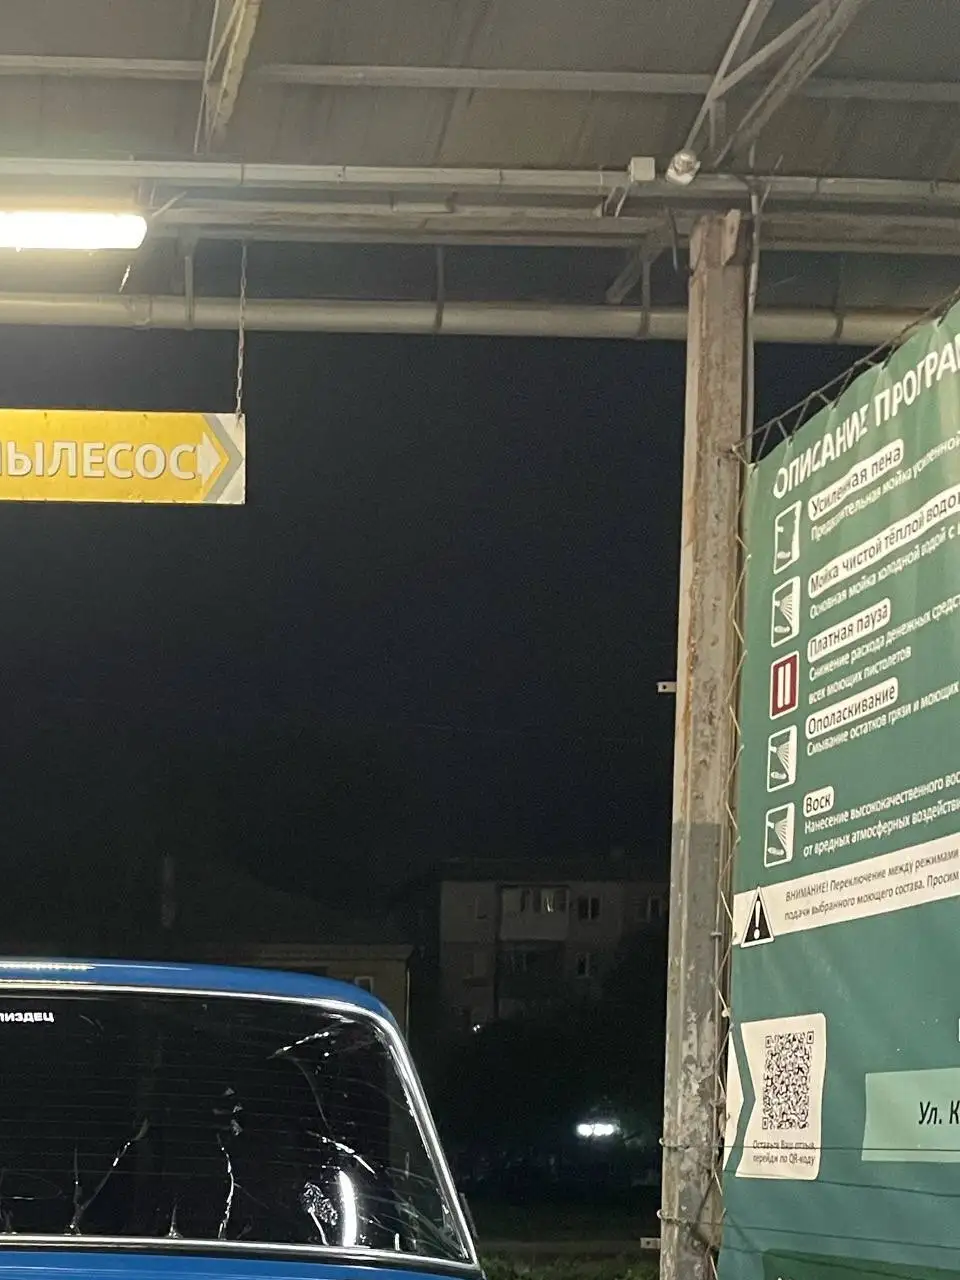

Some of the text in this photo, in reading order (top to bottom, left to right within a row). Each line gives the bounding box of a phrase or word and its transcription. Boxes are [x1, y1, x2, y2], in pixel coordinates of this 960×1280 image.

[772, 333, 960, 499] ОПИСАНИЕ ПРОГРА
[871, 447, 901, 478] пена
[811, 565, 839, 593] Мойка
[842, 538, 882, 571] чистой
[884, 511, 924, 549] тёплой
[848, 573, 876, 598] мойка
[810, 604, 888, 657] Платная пауза
[826, 671, 862, 696] моющих
[808, 685, 895, 734] Ополаскивание
[849, 714, 887, 739] остатков
[888, 703, 912, 725] грязи
[913, 700, 920, 712] и
[920, 681, 959, 709] моющих
[804, 811, 849, 834] Нанесение
[850, 778, 944, 820] высококачественного
[806, 793, 831, 813] Воск
[803, 845, 813, 857] от
[814, 836, 851, 855] вредных
[851, 815, 910, 844] атмосферных
[785, 849, 959, 902] ВНИМАНИЕ! Переключение между режимами
[811, 897, 855, 916] выбранного
[856, 888, 894, 905] моющего
[894, 880, 925, 895] состава.
[926, 872, 960, 889] Просим
[919, 1101, 942, 1125] Ул.
